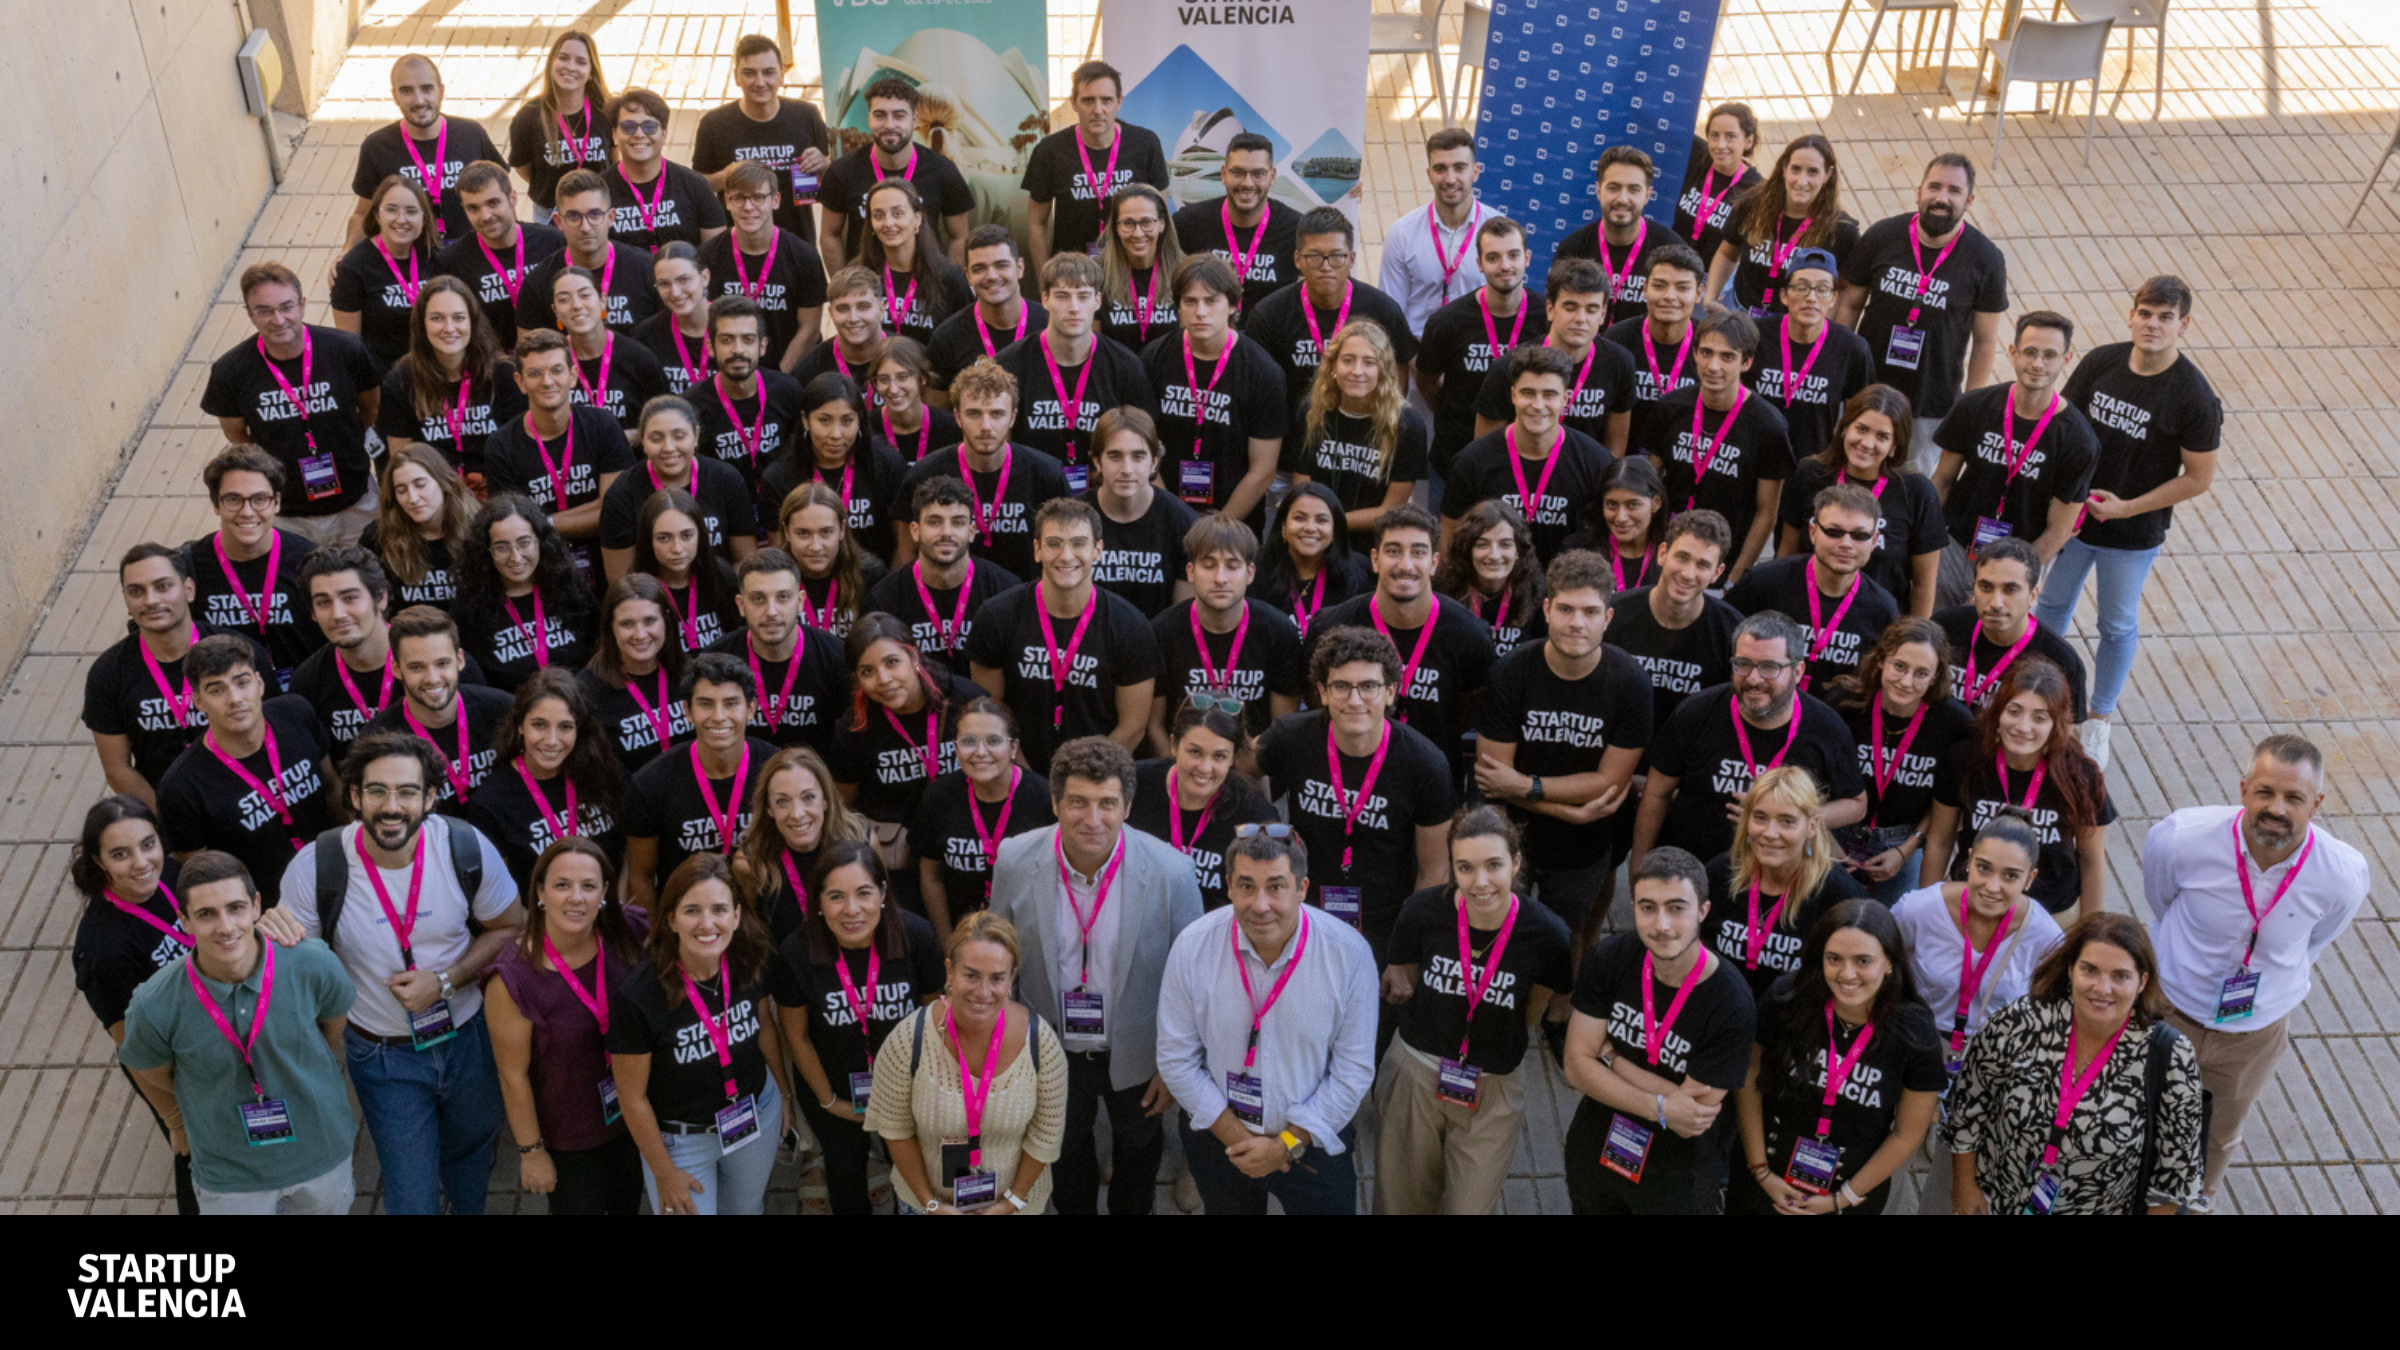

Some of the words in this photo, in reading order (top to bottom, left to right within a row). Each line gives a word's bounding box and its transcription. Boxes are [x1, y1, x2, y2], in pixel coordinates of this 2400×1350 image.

[1178, 5, 1294, 25] VALENCIA
[543, 148, 606, 165] VLECIA
[735, 146, 794, 160] STARTUP
[400, 162, 464, 178] STRUP
[1073, 170, 1133, 186] STRUP
[1245, 267, 1275, 282] NCIA
[1886, 267, 1949, 294] STARUP
[724, 282, 786, 297] STRUP
[1880, 278, 1946, 310] VALECIA
[1635, 371, 1695, 389] TARUP
[1761, 369, 1828, 389] STRUP
[1166, 385, 1230, 406] STARTUP
[1756, 382, 1828, 403] VALNCIA
[1034, 400, 1100, 417] STAUP
[1161, 401, 1230, 425] VALECIA
[1563, 404, 1605, 417] ENCIA
[2093, 390, 2151, 423] STARTUP
[422, 418, 498, 441] VALNCIA
[1028, 416, 1098, 432] VALECI
[2089, 403, 2147, 440] VALENCIA
[716, 422, 778, 448] STARUP
[1678, 432, 1740, 460] STARUP
[716, 436, 780, 460] VALCIA
[1320, 440, 1380, 461] STARTUP
[1316, 453, 1380, 480] VALENCIA
[1673, 446, 1738, 478] VALCIA
[1978, 445, 2039, 480] VALECIA
[528, 464, 591, 493] STAUP
[529, 478, 596, 506] VALCIA
[1501, 494, 1568, 510] STTUP
[982, 502, 1024, 519] RTUP
[985, 519, 1028, 533] NCIA
[1092, 550, 1160, 567] TARTUP
[401, 584, 456, 601] VALEN
[912, 620, 971, 638] STARU
[1799, 624, 1860, 648] TATUP
[494, 629, 576, 663] VALECIA
[1803, 643, 1859, 666] LNCIA
[1024, 647, 1098, 672] STRUP
[1635, 656, 1702, 678] TARTUP
[1018, 662, 1097, 688] VALCIA
[1652, 674, 1700, 694] ENCIA
[138, 712, 208, 730] VALNC
[620, 701, 685, 734] STAU
[746, 711, 817, 726] ALNCIA
[1526, 711, 1604, 734] STARTUP
[620, 713, 696, 750] VALCI
[1522, 724, 1604, 748] VALENCIA
[877, 760, 962, 785] VALECIA
[1720, 760, 1768, 778] STAR
[1858, 760, 1934, 788] ANCIA
[240, 773, 322, 832] VALNCIA
[1299, 793, 1389, 830] VALECIA
[1976, 800, 2058, 826] STUP
[682, 813, 752, 837] STAU
[1972, 812, 2060, 844] VCIA
[678, 832, 748, 852] VALEC
[944, 854, 987, 872] VALE
[1721, 920, 1802, 952] STTUP
[1716, 935, 1801, 970] VALNCIA
[1424, 970, 1514, 1010] VALECIA
[822, 997, 914, 1026] VANCIA
[1611, 1002, 1691, 1056] STAUP
[1606, 1019, 1687, 1074] VALECIA
